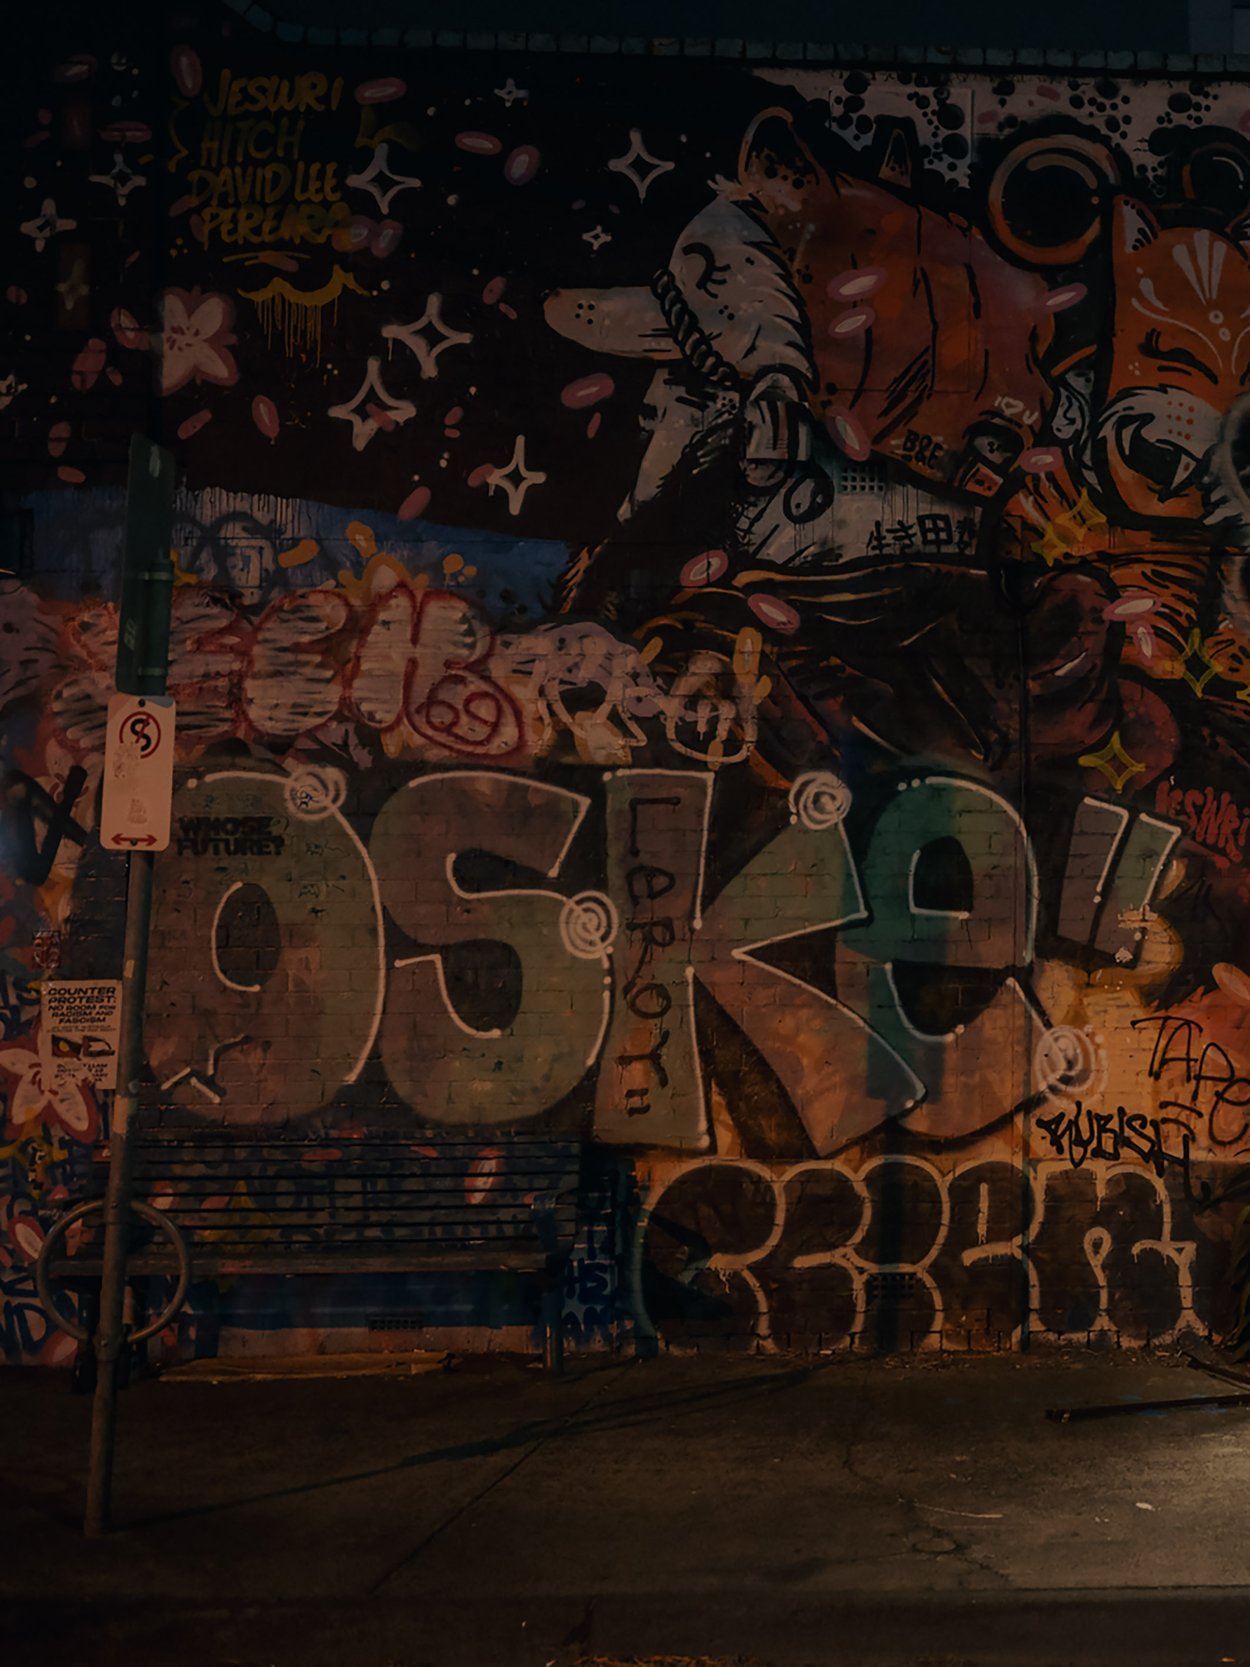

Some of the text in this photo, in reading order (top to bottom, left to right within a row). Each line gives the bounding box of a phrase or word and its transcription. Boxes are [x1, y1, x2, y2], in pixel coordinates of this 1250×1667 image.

[200, 116, 305, 167] HITCH
[186, 160, 343, 205] DAVID LEE
[178, 816, 274, 835] WHOSE
[176, 835, 285, 856] FUTURE?
[48, 986, 117, 996] COUNTER
